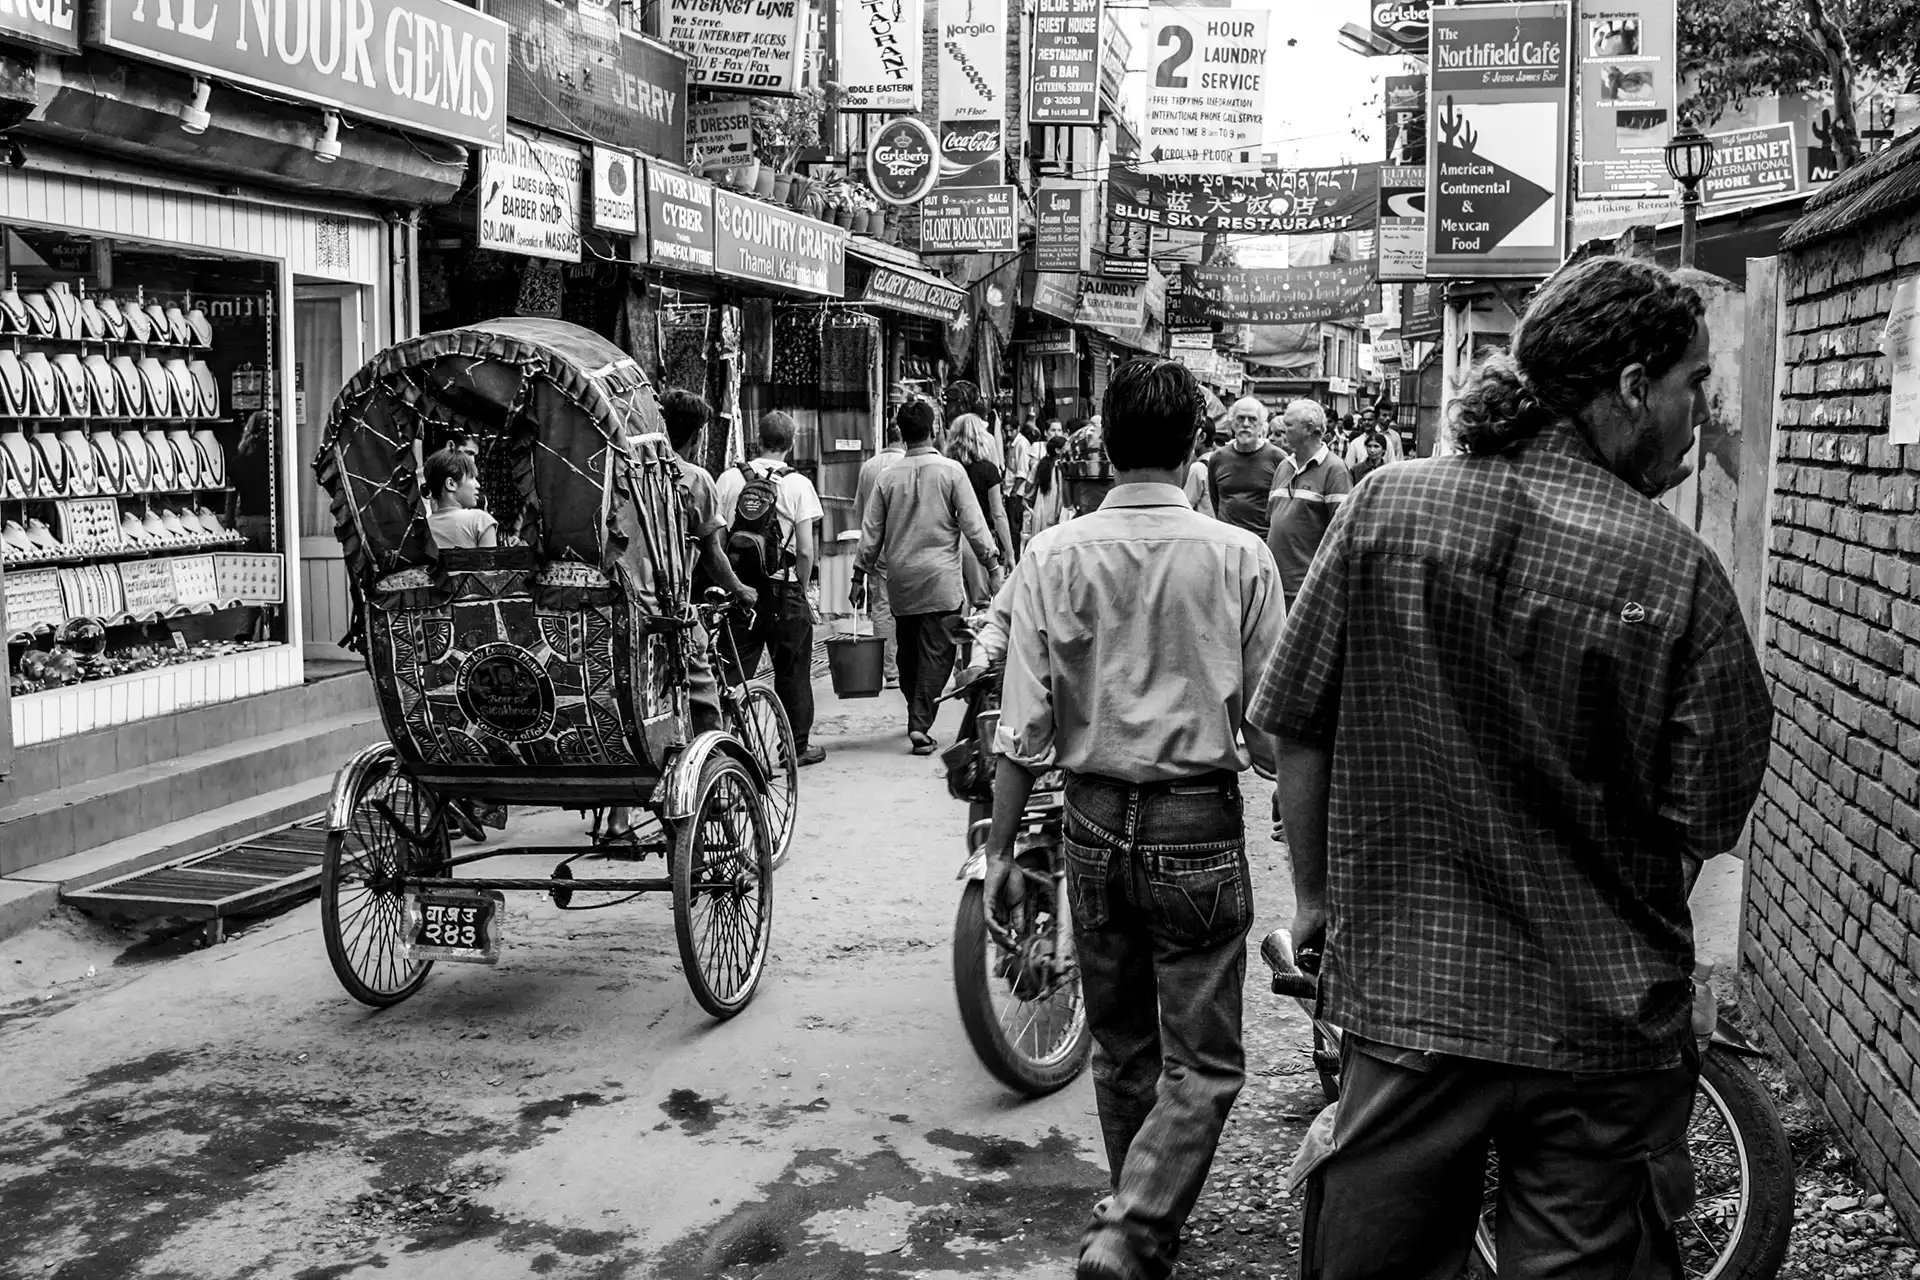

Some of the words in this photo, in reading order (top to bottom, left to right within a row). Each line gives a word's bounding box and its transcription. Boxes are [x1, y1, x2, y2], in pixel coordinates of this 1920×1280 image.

[671, 0, 752, 15] INTERNET
[756, 1, 795, 20] LINK
[1039, 0, 1070, 12] BLUE
[1072, 0, 1097, 12] SKY
[673, 15, 687, 25] We
[1373, 3, 1429, 28] Carlsbe
[946, 24, 996, 38] Nargila
[1038, 17, 1066, 34] GUEST
[1068, 17, 1096, 34] HOUSE
[1438, 27, 1458, 40] The
[670, 27, 695, 40] FULL
[698, 30, 751, 44] INTERNET
[752, 33, 787, 47] ACCESS
[861, 0, 909, 80] TAURANT
[236, 0, 375, 88] NOOR
[384, 6, 497, 122] GEMS
[1038, 48, 1094, 62] RESTAURANT
[1156, 25, 1194, 88] 2
[1208, 21, 1254, 37] HOUR
[1204, 47, 1266, 65] LAUNDRY
[1438, 43, 1519, 68] Northfield
[1522, 41, 1561, 66] Café
[711, 71, 745, 84] ISD
[748, 74, 782, 87] IDD
[1049, 65, 1058, 78] &
[1059, 65, 1080, 78] BAR
[1482, 73, 1491, 83] &
[1492, 71, 1515, 83] Jesse
[1516, 71, 1541, 83] James
[1542, 70, 1559, 82] Bar
[876, 84, 914, 93] EASTERN
[1035, 82, 1067, 93] CATERING
[1067, 82, 1095, 93] SERVICE
[1202, 73, 1261, 91] SERVICE
[611, 67, 677, 126] JERRY
[847, 98, 868, 106] FOOD
[887, 96, 911, 105] Floor
[1153, 96, 1169, 105] FREE
[967, 107, 988, 116] Floor
[1152, 111, 1198, 121] INTERNATIONAL
[1200, 112, 1221, 122] PHONE
[1223, 113, 1237, 123] CALL
[1238, 113, 1263, 124] SERVICE
[700, 115, 749, 133] DRESSER
[1151, 127, 1179, 136] OPENING
[1182, 127, 1198, 137] TIME
[706, 144, 726, 155] SHOP
[942, 131, 1000, 152] Coca-Cola
[875, 146, 929, 165] Carlsberg
[1164, 149, 1198, 161] GROUND
[1203, 149, 1233, 162] FLOOR
[1712, 140, 1790, 167] NTERNET
[889, 165, 918, 176] Beer
[1382, 167, 1425, 178] ULTIM
[1440, 163, 1494, 175] American
[512, 174, 537, 195] LADIES
[538, 183, 544, 196] &
[650, 168, 688, 202] INTER
[688, 179, 712, 208] LINK
[1440, 180, 1511, 195] Continental
[1706, 174, 1751, 191] PHONE
[1758, 169, 1792, 183] CALL
[988, 193, 1008, 203] SALE
[1165, 189, 1319, 216] 蓝天饭店
[1461, 200, 1475, 213] &
[1637, 200, 1680, 210] Retreats
[501, 194, 537, 221] BARBER
[539, 202, 563, 225] SHOP
[662, 201, 704, 232] CYBER
[1115, 203, 1160, 223] BLUE
[1167, 213, 1210, 229] SKY
[1217, 214, 1353, 232] RESTAURANT
[923, 218, 951, 242] GLORY
[952, 217, 978, 241] BOOK
[978, 216, 1012, 240] CENTER
[1441, 219, 1490, 232] Mexican
[482, 219, 516, 244] SALOON
[544, 230, 580, 255] MASSAGE
[732, 204, 797, 252] COUNTRY
[798, 229, 843, 265] CRAFTS
[1452, 237, 1480, 250] Food
[739, 247, 778, 279] Thamel,
[779, 256, 829, 290] Kathmandu
[873, 269, 909, 297] GLORY
[904, 280, 930, 302] BOOK
[927, 286, 963, 311] CENTRE
[519, 651, 546, 679] Planet
[479, 704, 539, 717] Steakhouse
[476, 718, 495, 734] You
[426, 923, 477, 947] २४३
